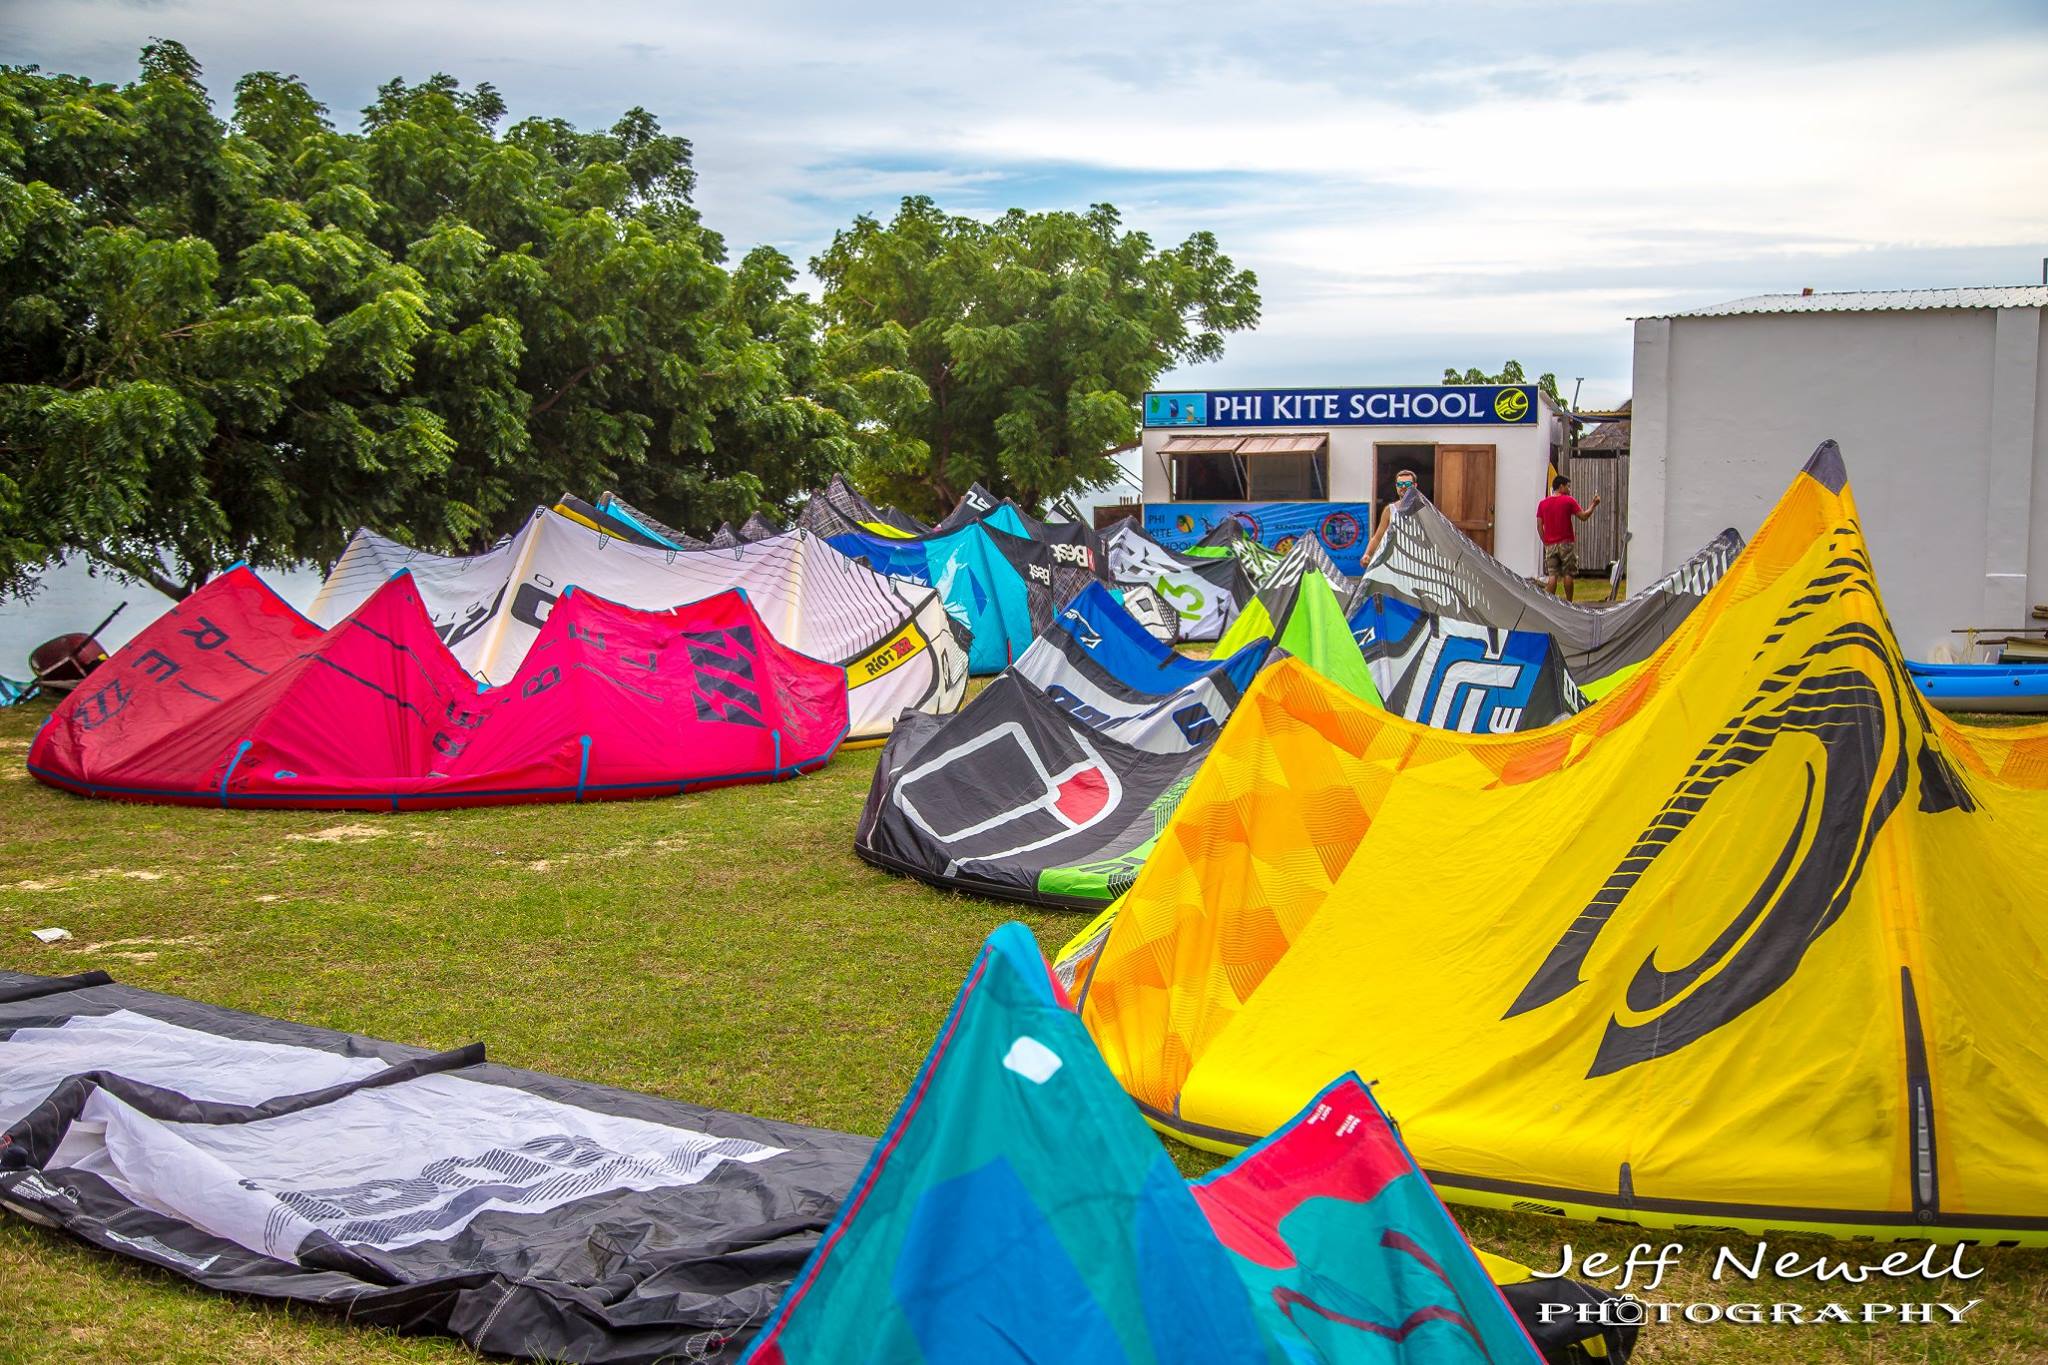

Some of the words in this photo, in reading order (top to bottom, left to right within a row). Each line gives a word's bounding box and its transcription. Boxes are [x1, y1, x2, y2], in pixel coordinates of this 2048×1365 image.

[1213, 395, 1262, 421] PHI
[1272, 394, 1341, 420] KITE
[1349, 392, 1486, 419] SCHOOL
[1149, 514, 1166, 524] PHI
[1149, 528, 1172, 538] KITE
[1049, 543, 1089, 569] Best
